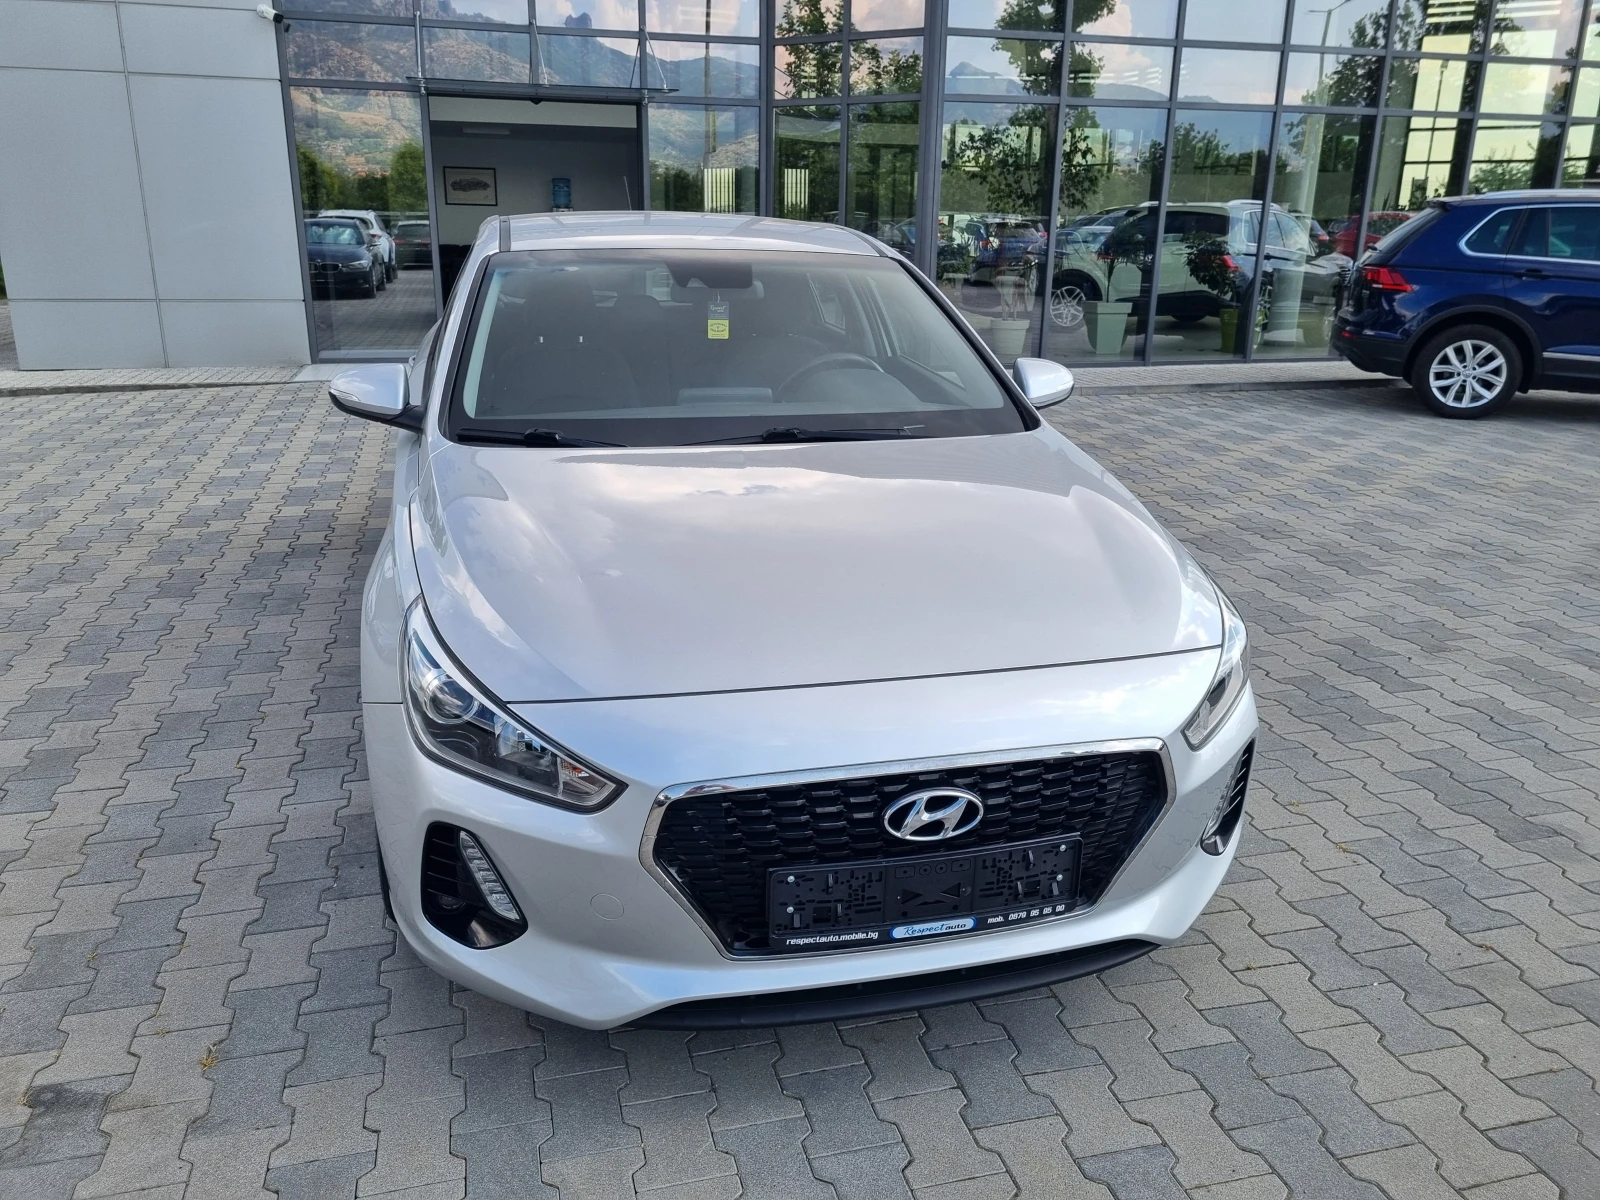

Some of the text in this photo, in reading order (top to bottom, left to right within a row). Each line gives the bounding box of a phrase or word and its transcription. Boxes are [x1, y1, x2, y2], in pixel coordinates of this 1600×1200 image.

[987, 915, 1005, 924] mob.
[903, 923, 947, 936] Respect
[786, 931, 879, 946] respectauto.mobile.bg
